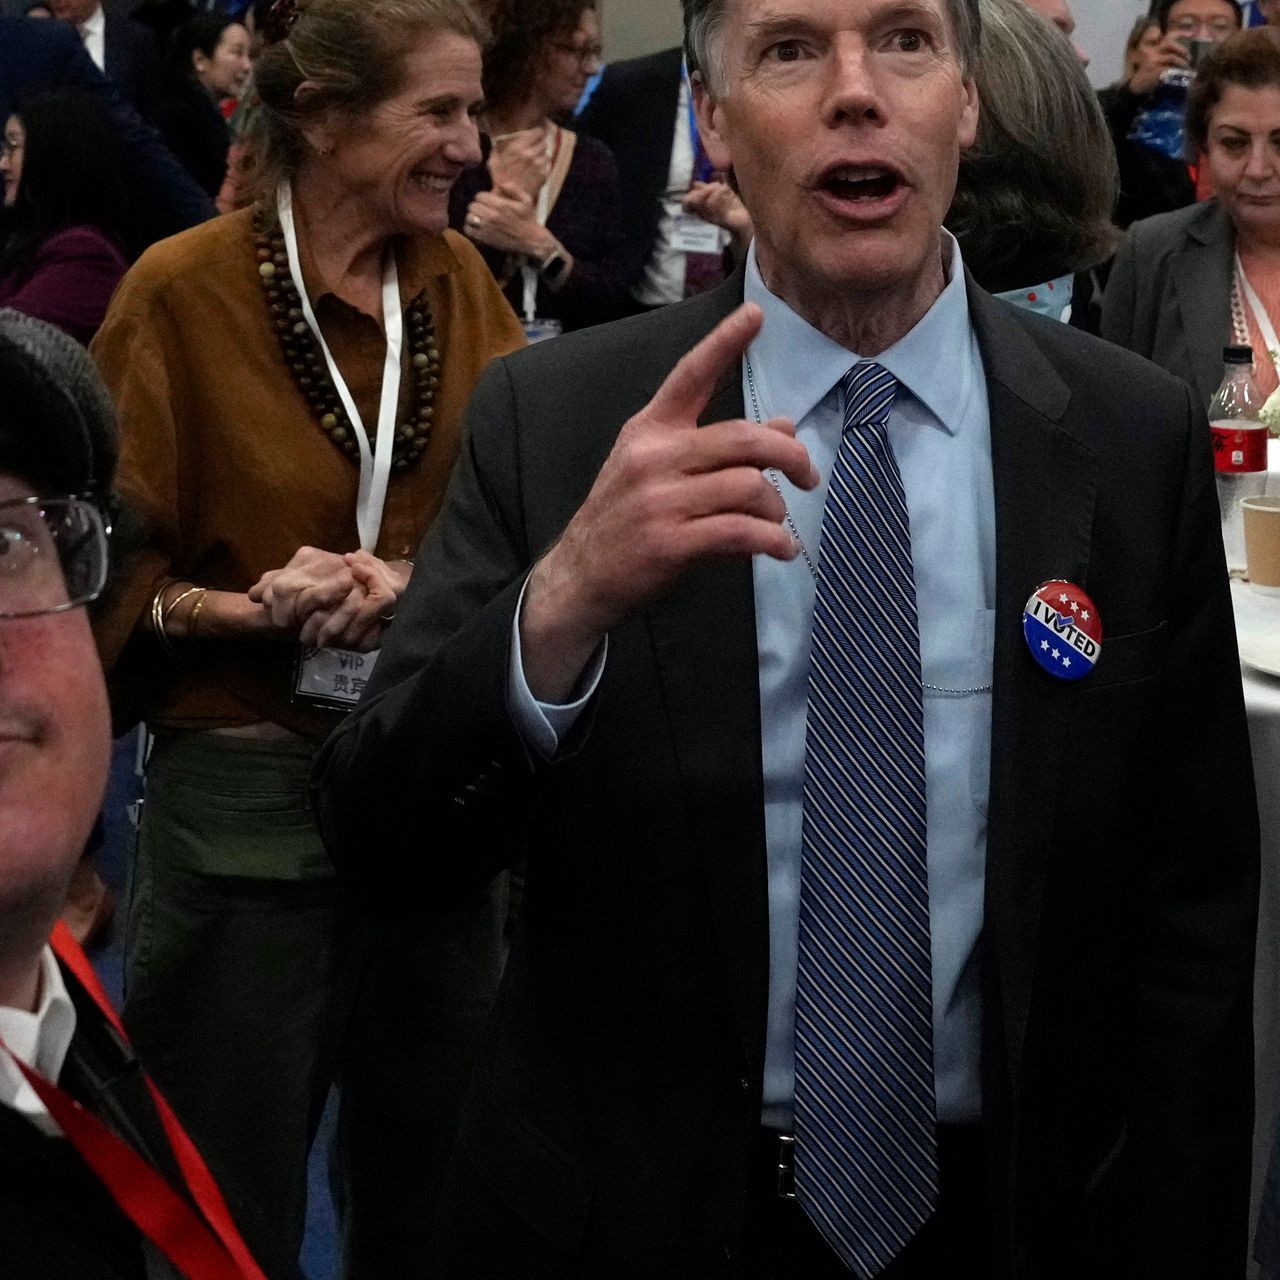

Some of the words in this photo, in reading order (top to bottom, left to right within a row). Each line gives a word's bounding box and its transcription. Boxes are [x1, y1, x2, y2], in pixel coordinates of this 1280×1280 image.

[1033, 600, 1042, 616] I
[1044, 606, 1096, 658] VOTED
[339, 656, 365, 671] VIP
